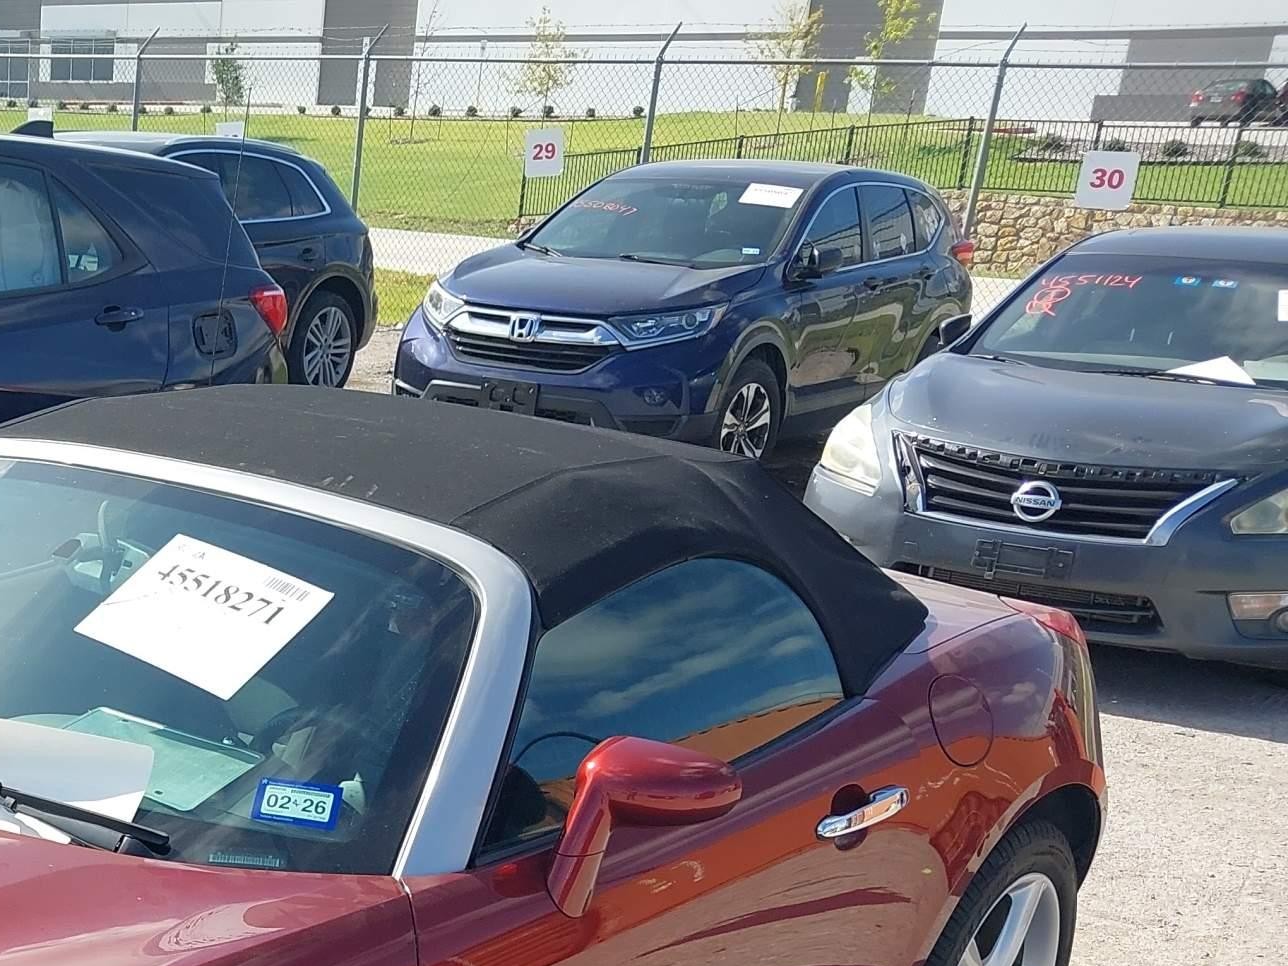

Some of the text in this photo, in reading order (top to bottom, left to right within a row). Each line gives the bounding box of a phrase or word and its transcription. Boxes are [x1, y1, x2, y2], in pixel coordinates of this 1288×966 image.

[532, 142, 557, 161] 29
[1088, 168, 1126, 190] 30
[1015, 495, 1056, 508] NISSAN
[157, 563, 286, 626] 45518271
[266, 793, 292, 810] 02
[301, 798, 327, 815] 26
